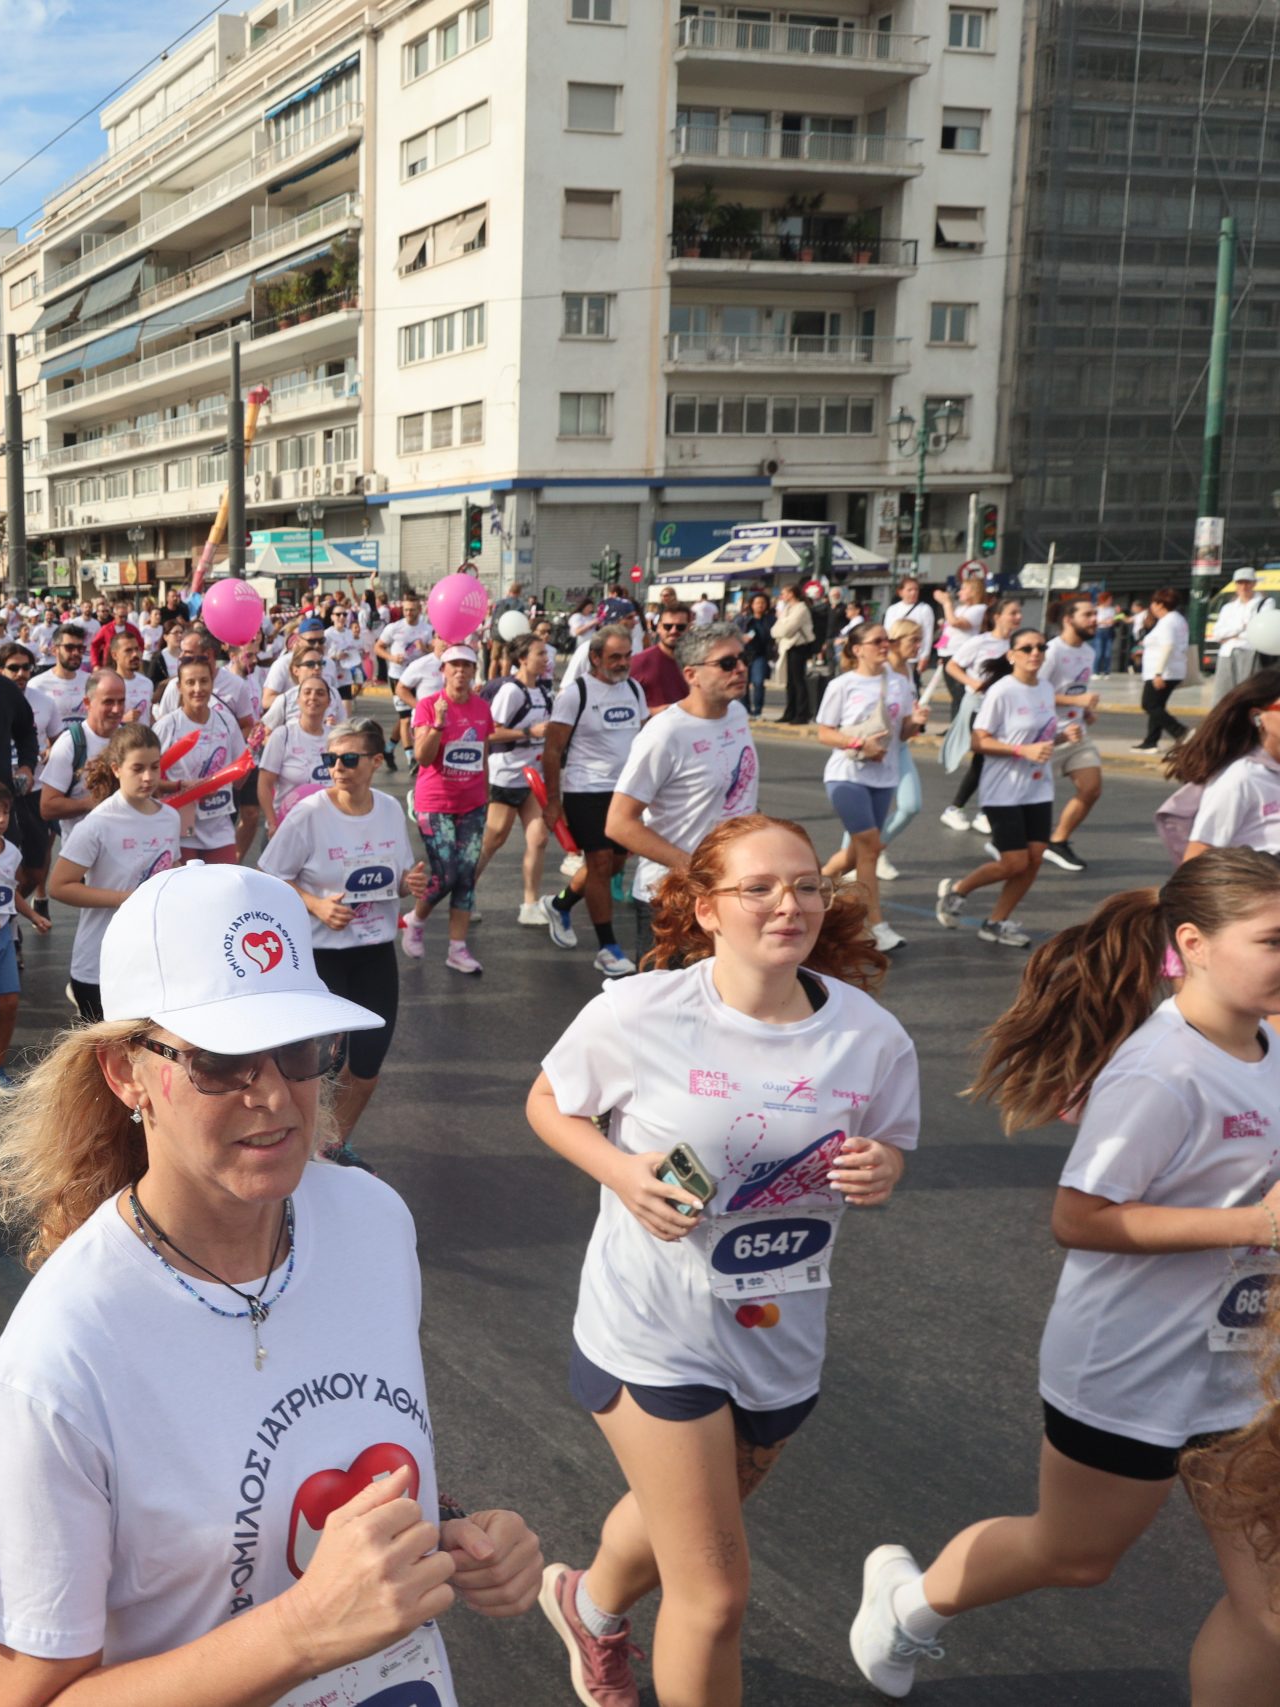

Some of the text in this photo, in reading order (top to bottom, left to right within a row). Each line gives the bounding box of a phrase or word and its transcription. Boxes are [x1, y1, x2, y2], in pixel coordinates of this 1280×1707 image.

[358, 872, 384, 886] 474
[223, 911, 300, 978] ΟΜΙΛΟΣ ΙΑΤΡΙΚΟΥ ΑΘΗΝΩΝ
[696, 1070, 729, 1081] RACE
[734, 1230, 809, 1259] 6547
[231, 1448, 271, 1589] ΟΜΙΛΟΣ
[257, 1372, 368, 1451] ΙΑΤΡΙΚΟΥ
